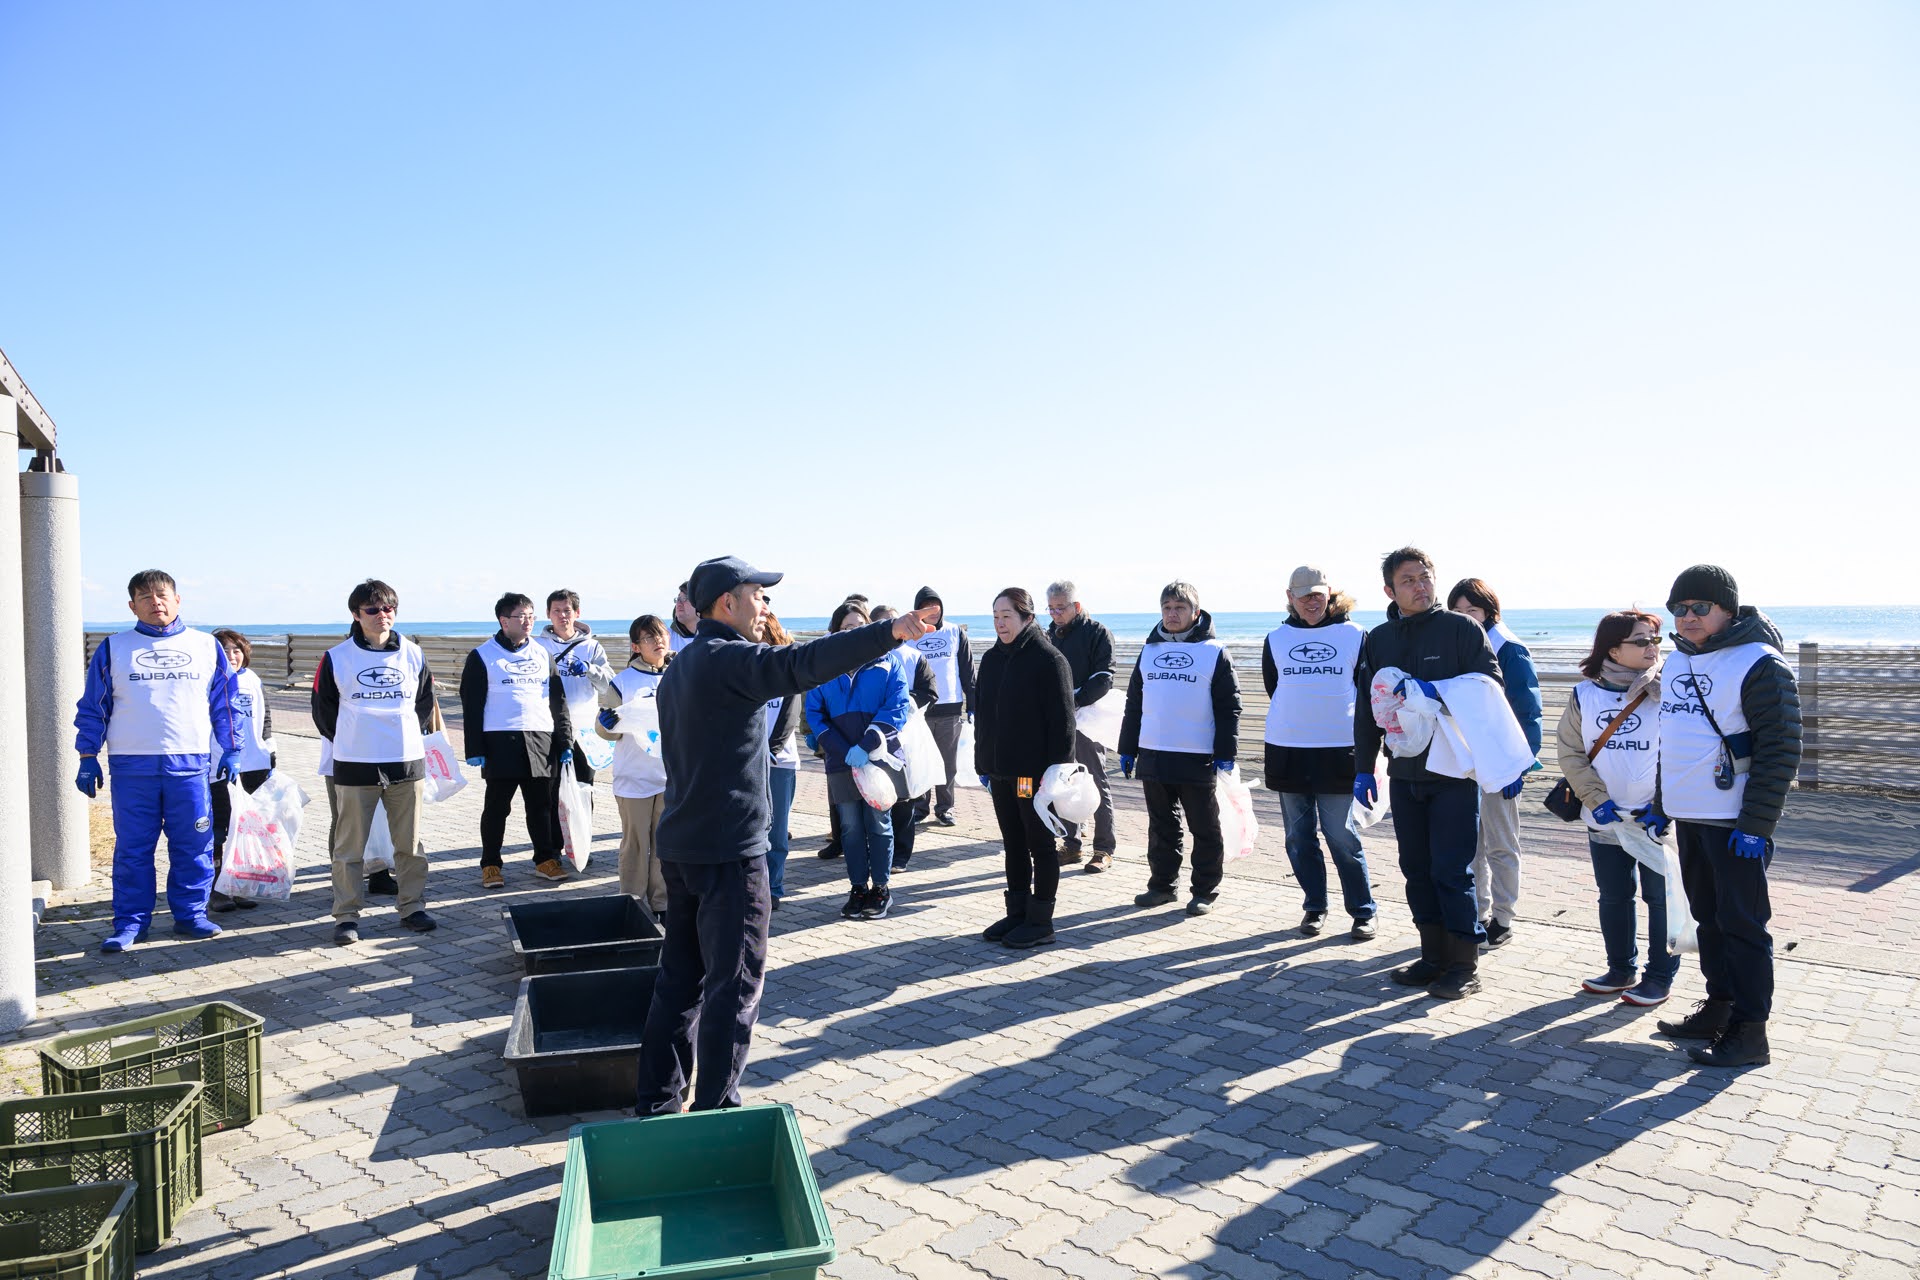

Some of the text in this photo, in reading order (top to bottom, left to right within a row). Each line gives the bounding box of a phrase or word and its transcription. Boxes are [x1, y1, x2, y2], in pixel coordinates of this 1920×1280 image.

[924, 651, 952, 660] BARU
[1282, 666, 1343, 676] SUBARU
[129, 672, 200, 681] SUBARU
[1147, 672, 1197, 683] SUBARU
[351, 690, 412, 700] SUBARU
